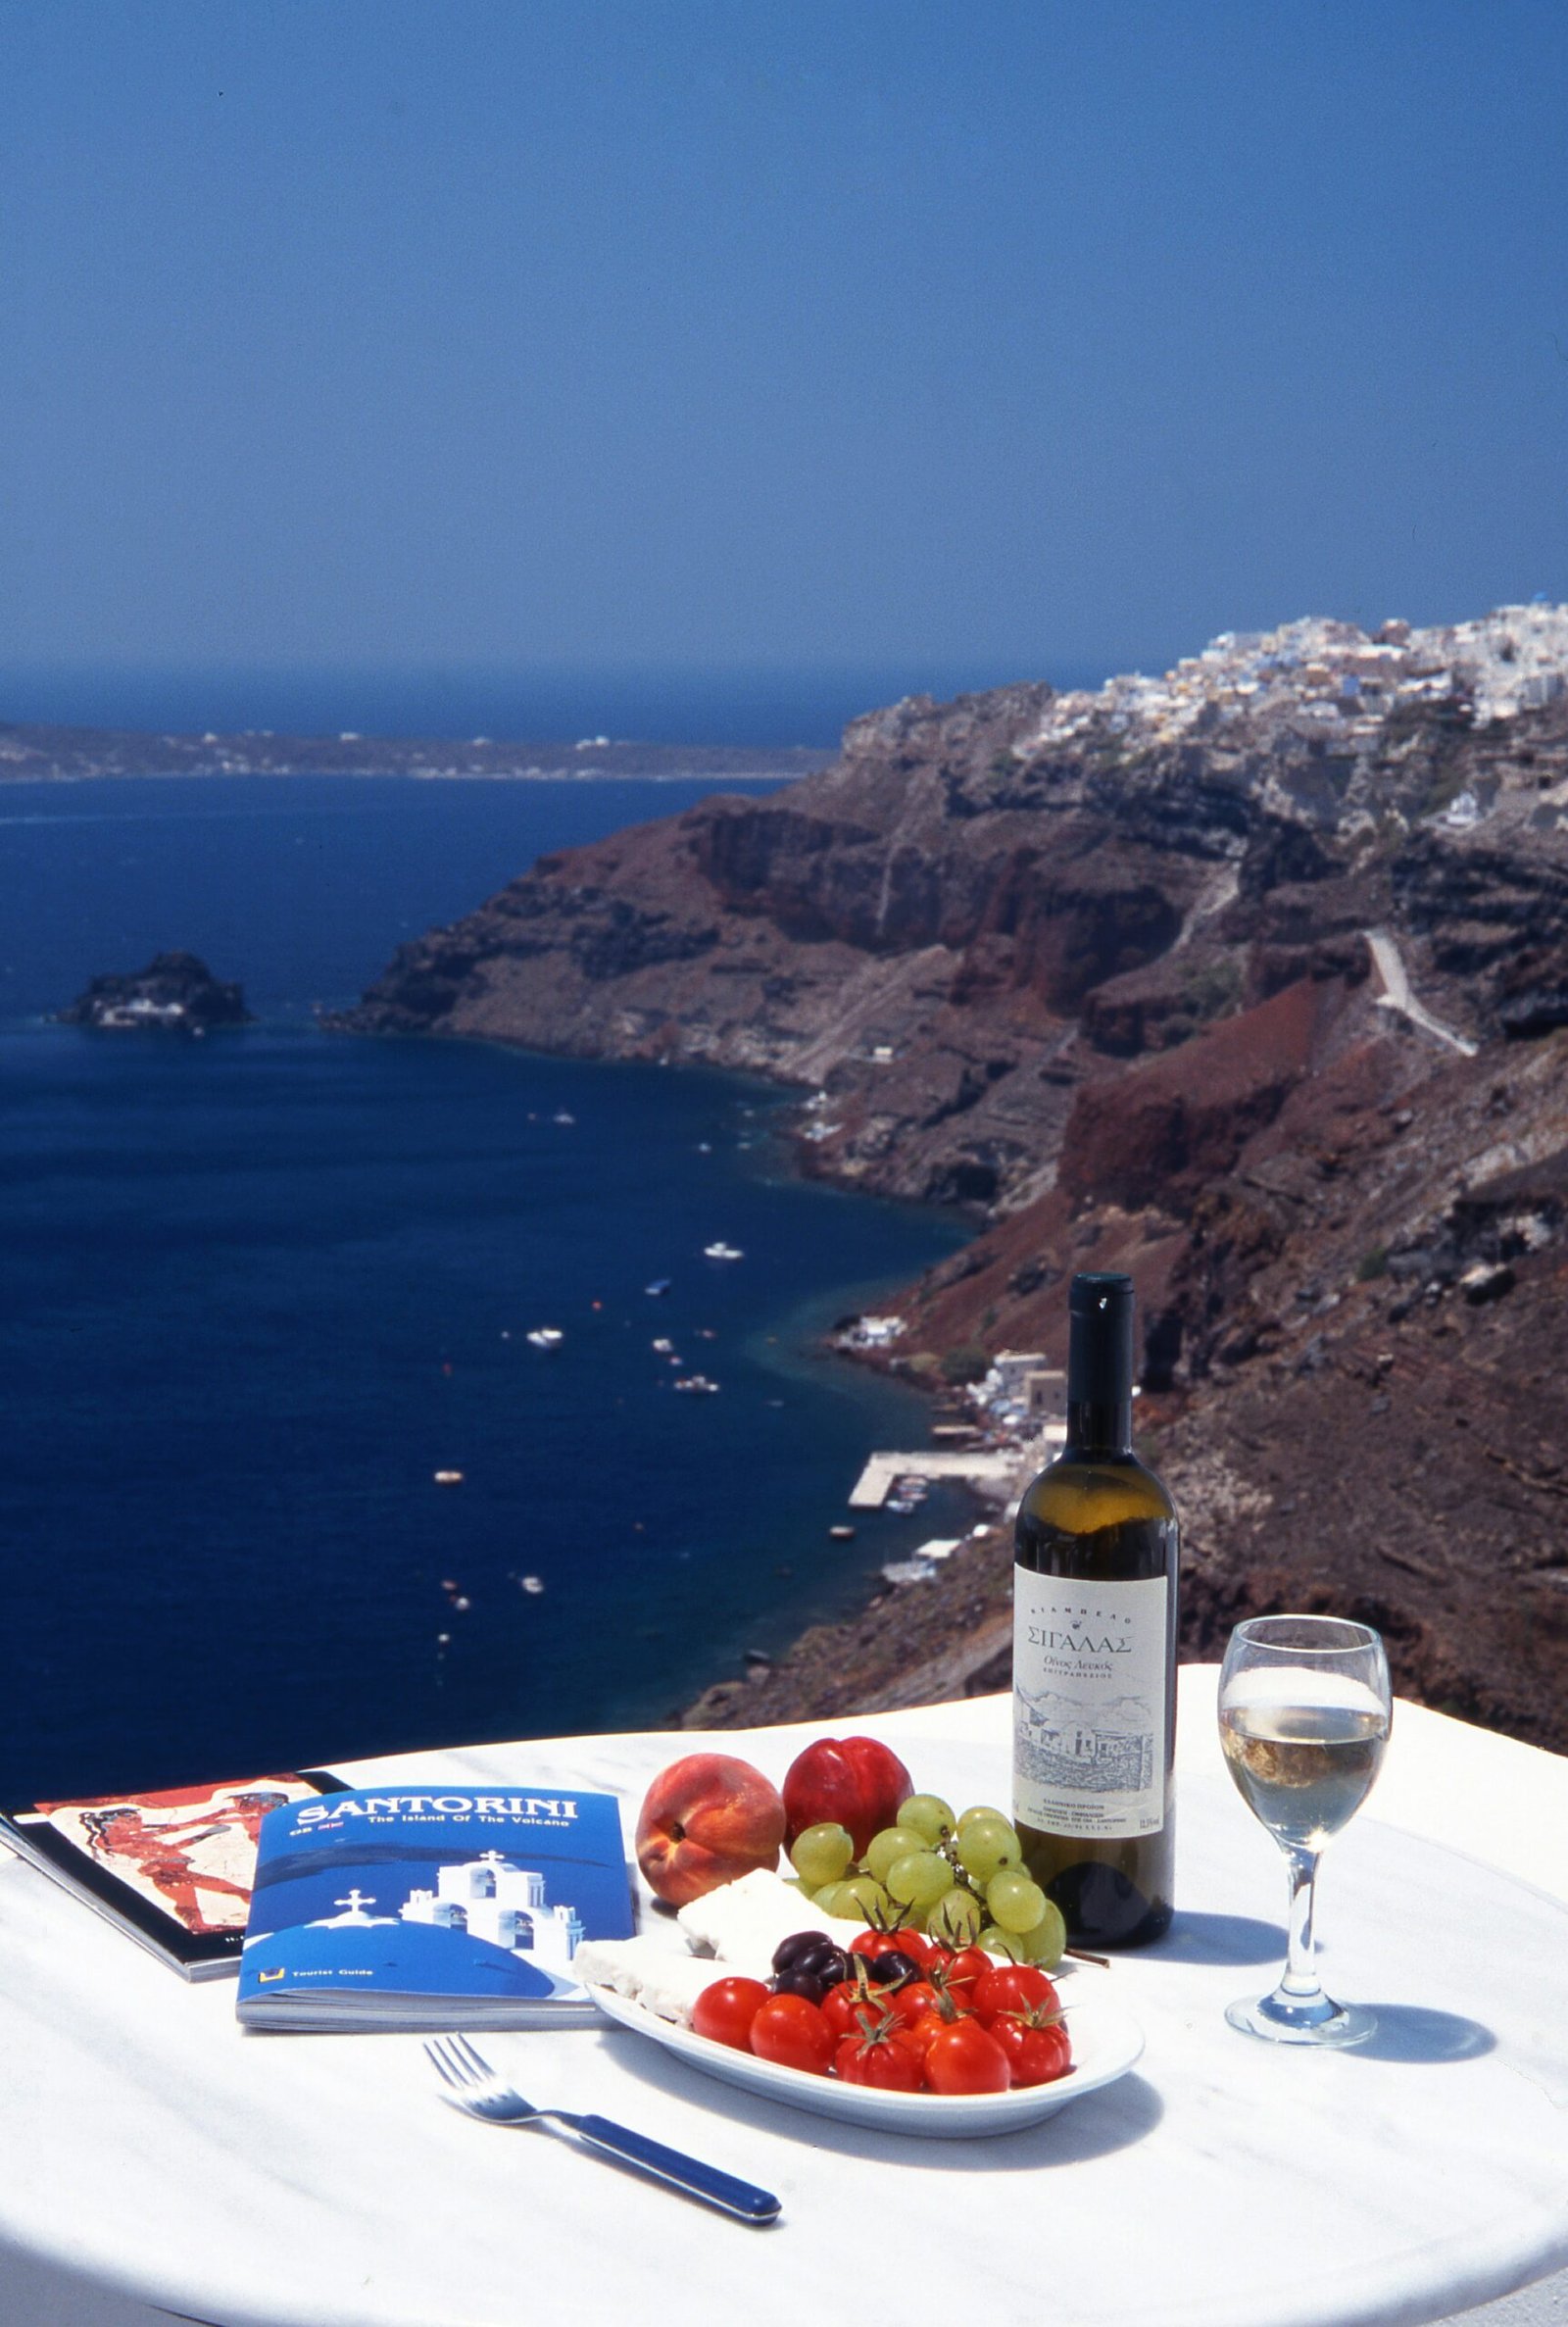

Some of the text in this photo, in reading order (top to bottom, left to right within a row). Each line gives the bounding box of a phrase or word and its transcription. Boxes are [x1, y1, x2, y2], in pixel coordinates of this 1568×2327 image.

[1028, 1625, 1135, 1654] ΣΙΓΑΛΑΣ
[297, 1796, 578, 1825] SANTORINI
[368, 1815, 394, 1824] The
[478, 1814, 505, 1823] The
[512, 1815, 570, 1827] Volcano
